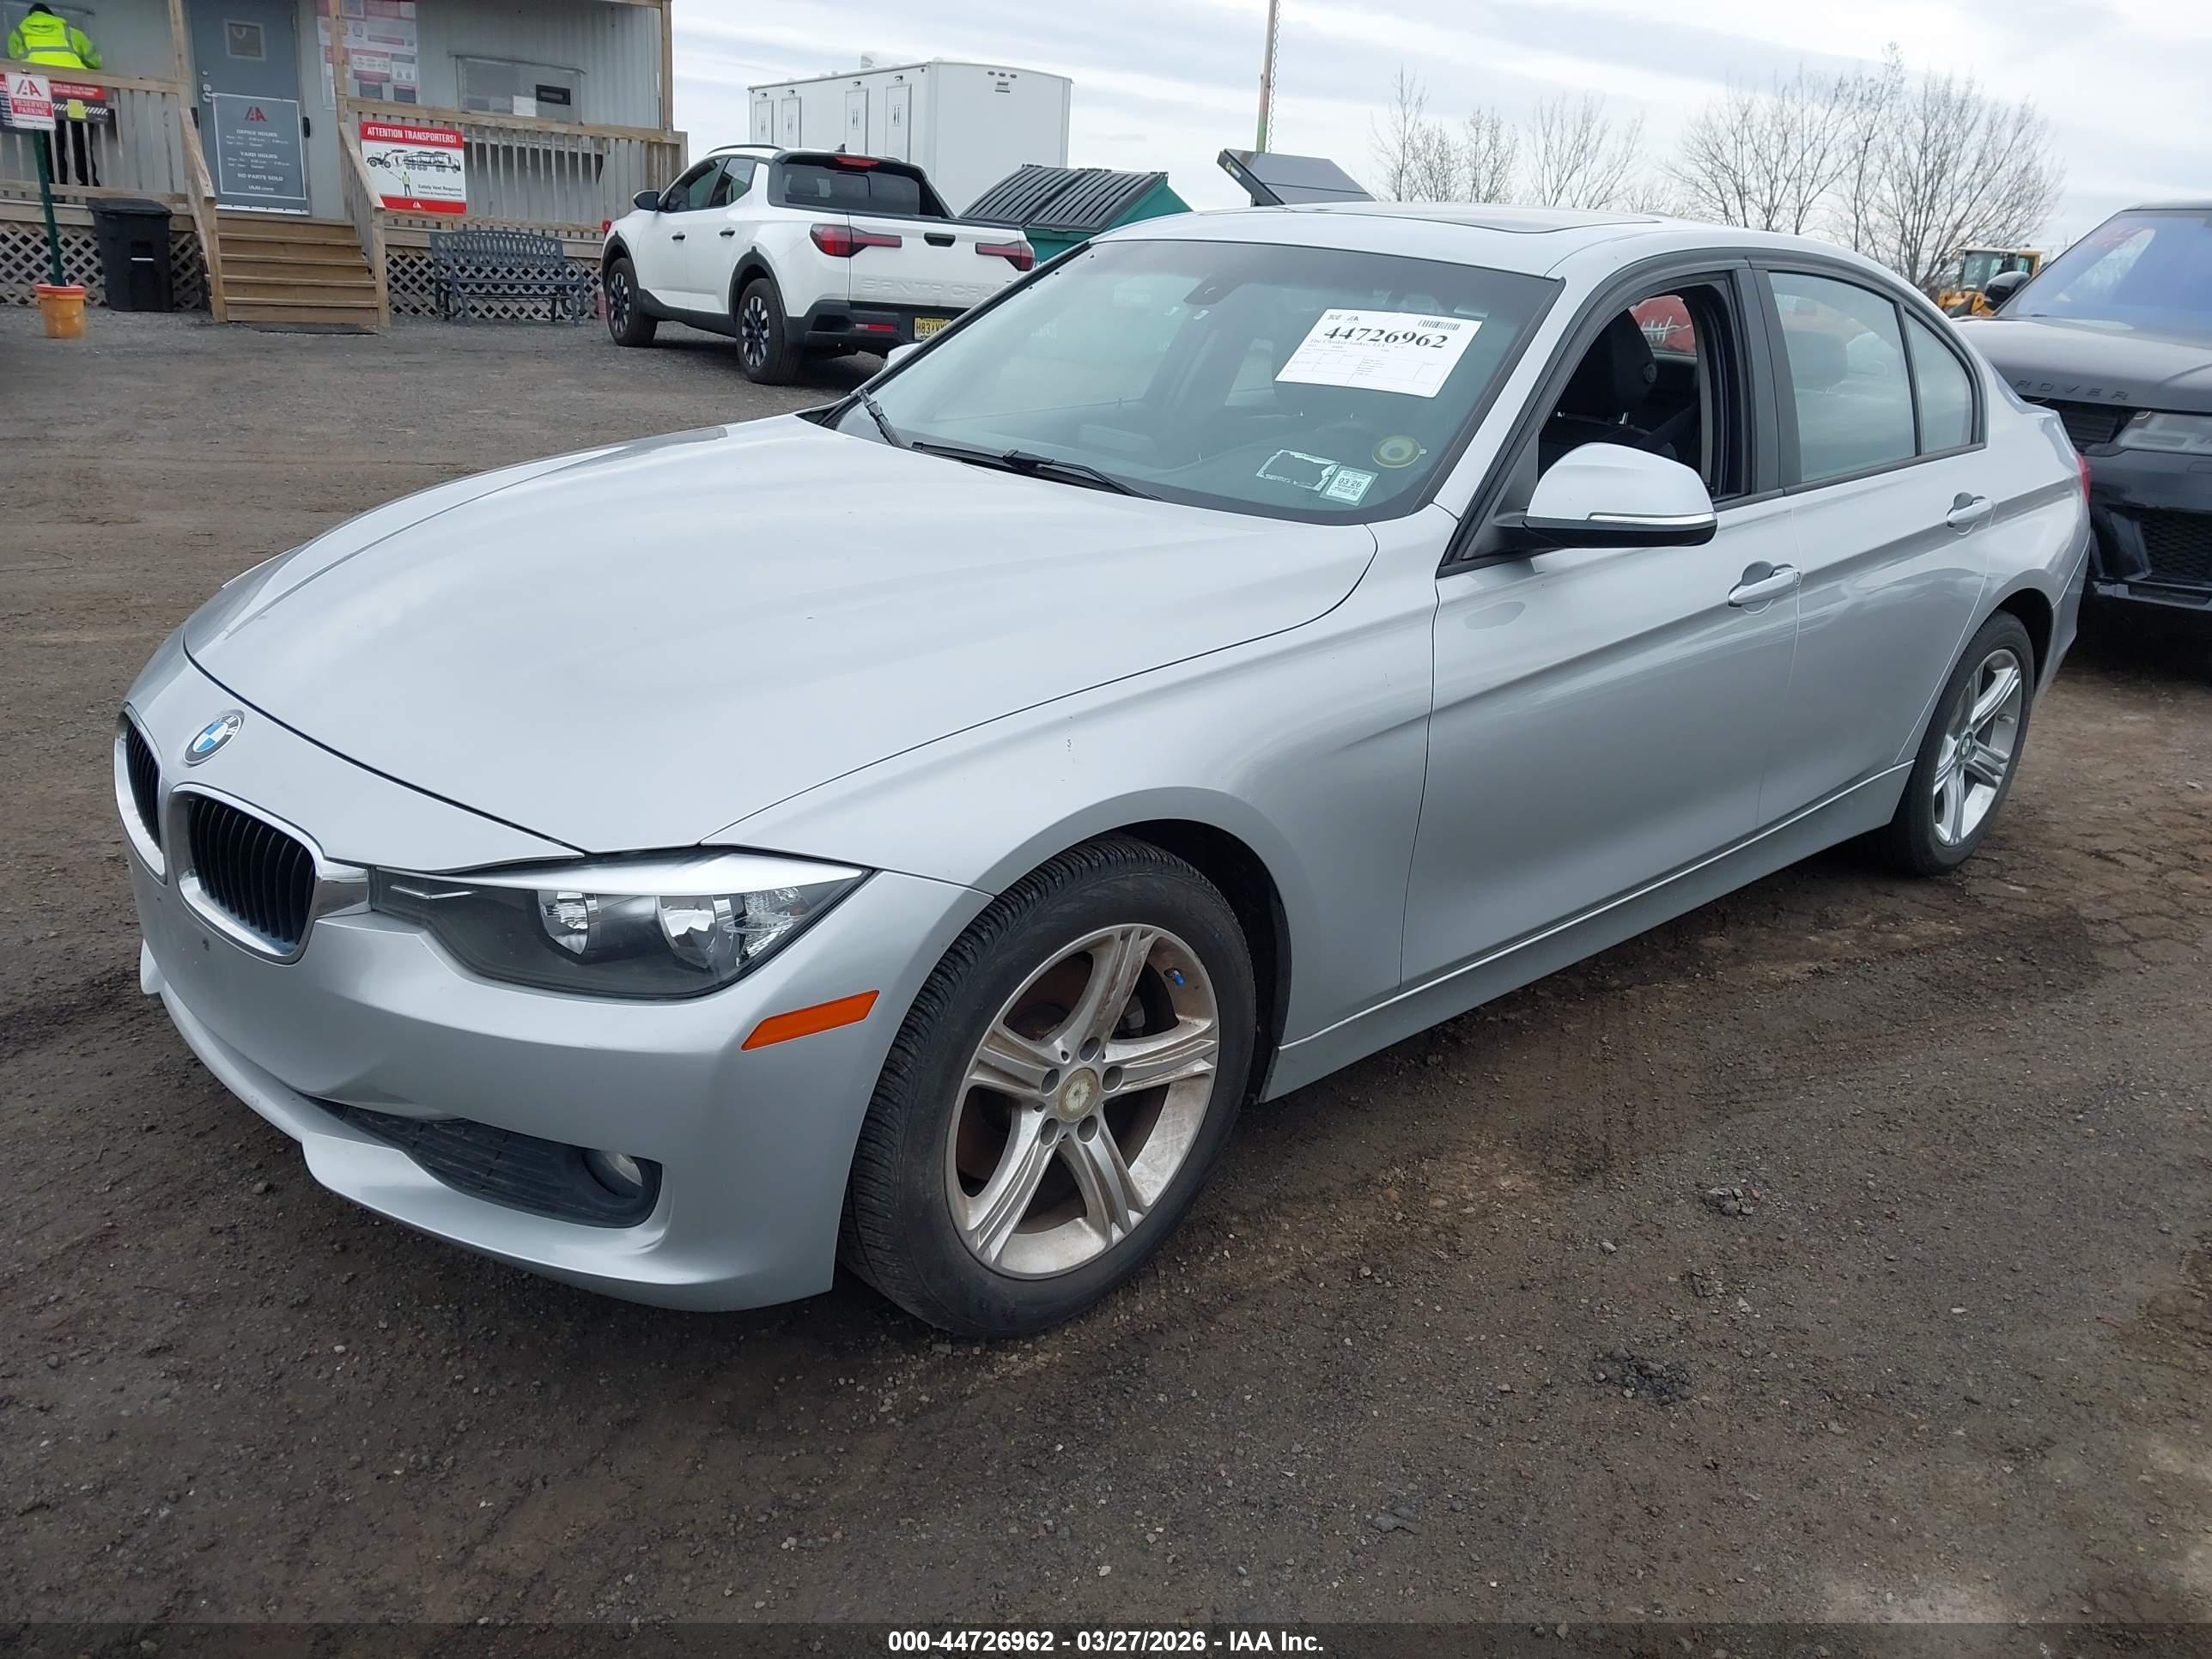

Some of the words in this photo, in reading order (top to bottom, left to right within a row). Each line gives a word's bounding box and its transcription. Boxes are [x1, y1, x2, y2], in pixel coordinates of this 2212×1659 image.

[14, 99, 49, 109] RESERVED
[17, 106, 48, 116] PARKING
[367, 126, 403, 138] ATTENTION
[404, 130, 457, 143] TRANSPORTERS!
[862, 277, 943, 297] SANTA
[1324, 326, 1449, 349] 44726962
[2016, 380, 2130, 401] ROVER
[1351, 480, 1364, 489] 26
